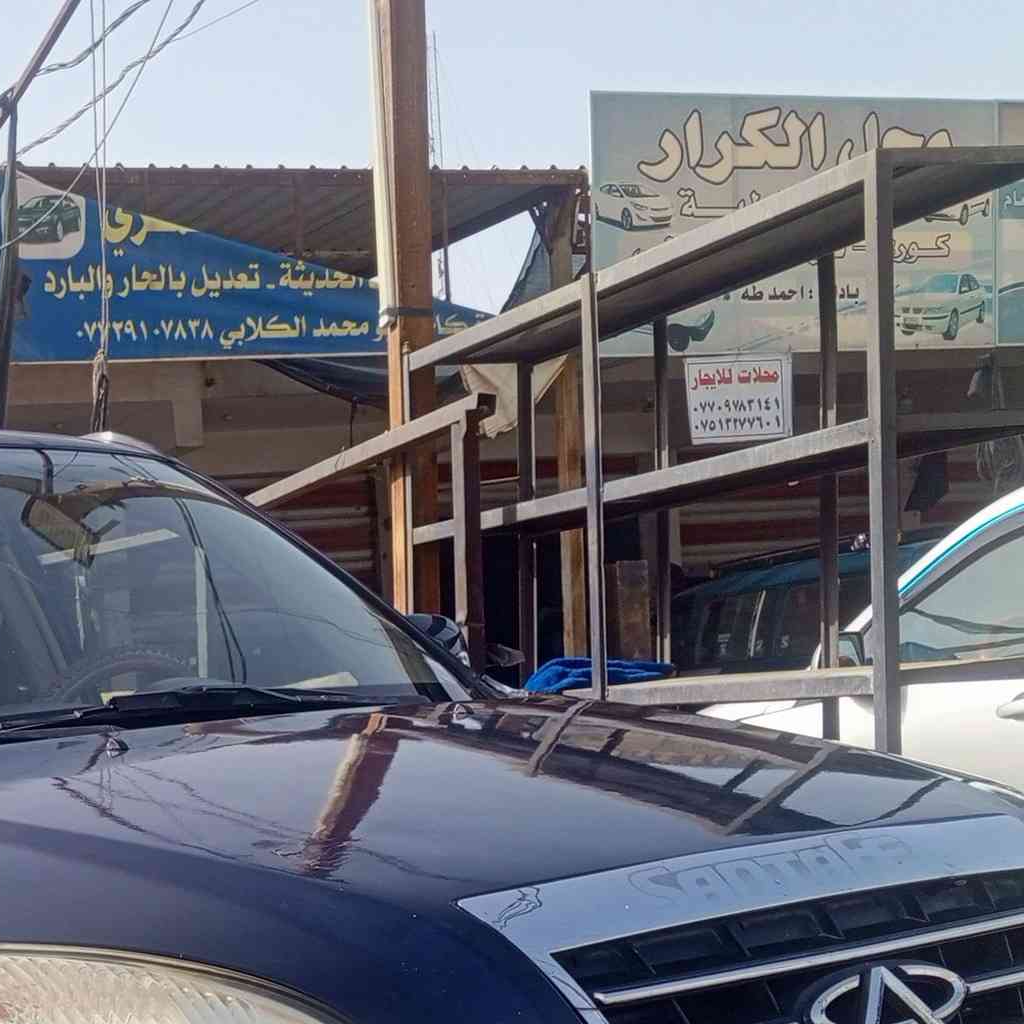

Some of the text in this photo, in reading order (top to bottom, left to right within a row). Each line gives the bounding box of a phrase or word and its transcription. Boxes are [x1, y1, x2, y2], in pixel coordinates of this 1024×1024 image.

[637, 106, 826, 185] الكرار
[117, 263, 186, 299] بالحار
[191, 262, 261, 299] تعديل
[219, 314, 307, 350] الكلابي
[312, 317, 370, 338] محمد
[737, 366, 779, 385] محلات
